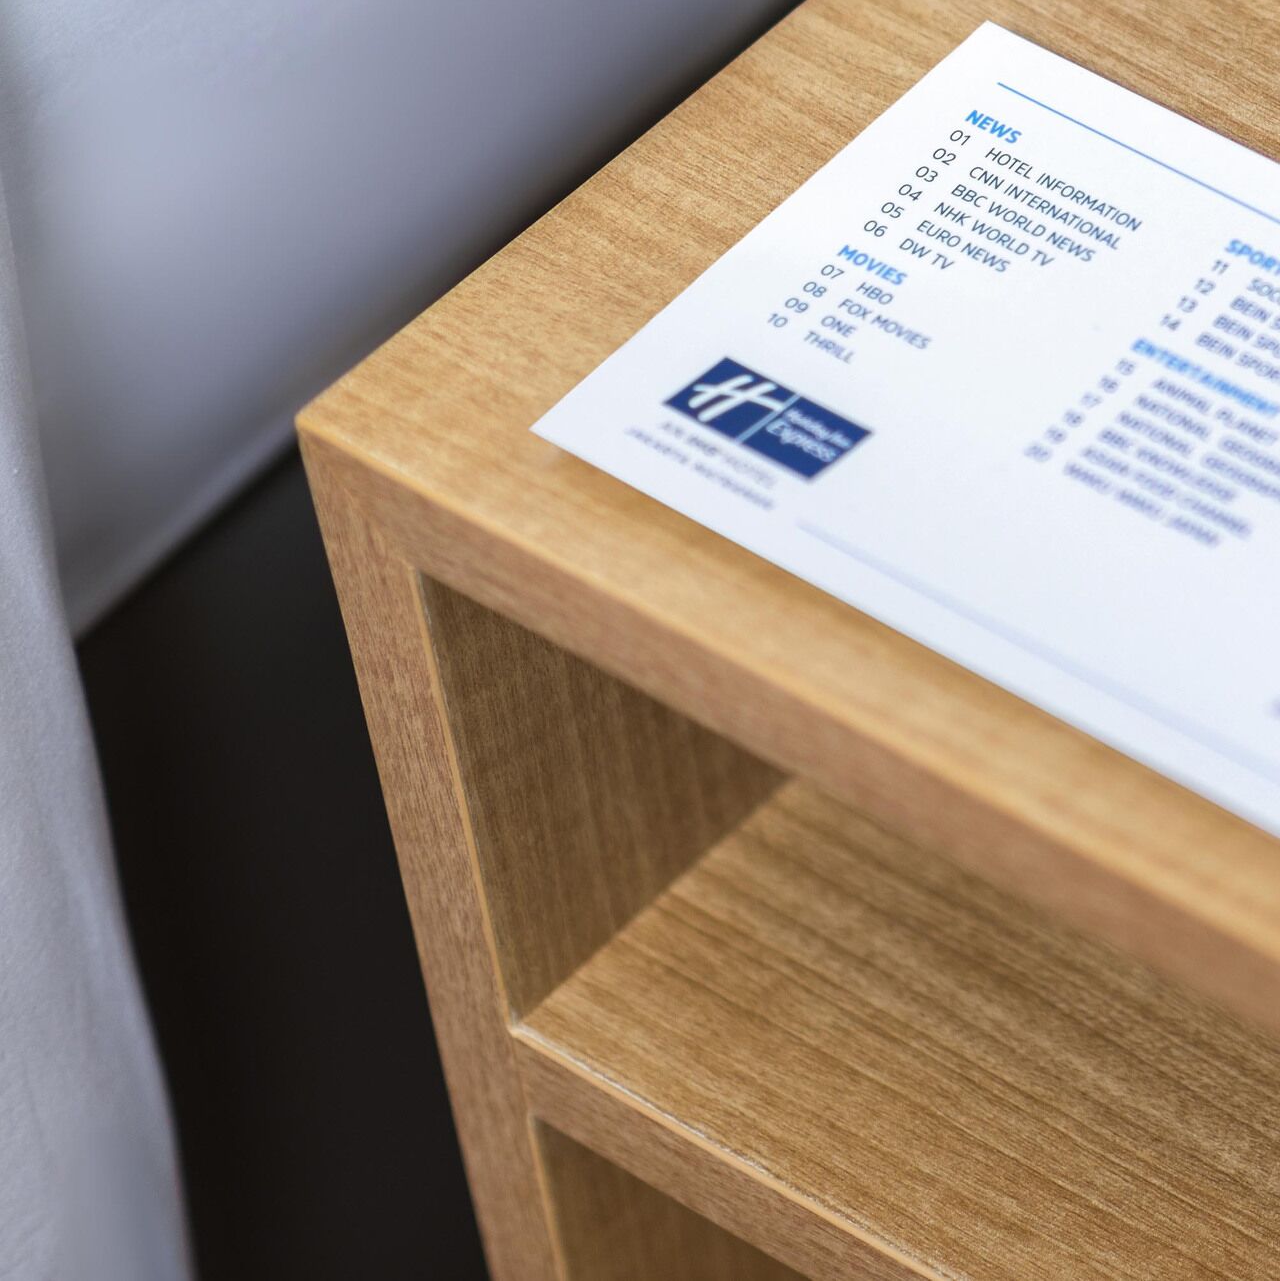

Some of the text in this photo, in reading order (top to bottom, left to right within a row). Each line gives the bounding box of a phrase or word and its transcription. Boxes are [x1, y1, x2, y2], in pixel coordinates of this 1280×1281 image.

[965, 109, 1022, 144] NEWS
[932, 148, 1120, 250] 02 CNN INTERNATIONAL
[949, 129, 1142, 232] 01 HOTEL INFORMATION
[880, 201, 1010, 272] 05 EURO NEWS
[898, 183, 1055, 267] 04 NHK WORLD TV
[915, 165, 1095, 262] 03 BBC WORLD NEWS
[836, 244, 908, 286] MOVIES
[863, 220, 954, 270] 06 DW TV
[820, 264, 894, 305] 07 HBO
[767, 313, 854, 364] 10 THRILL
[784, 297, 856, 337] 09 ONE
[802, 281, 931, 350] 08 FOX MOVIES
[765, 418, 838, 463] Express
